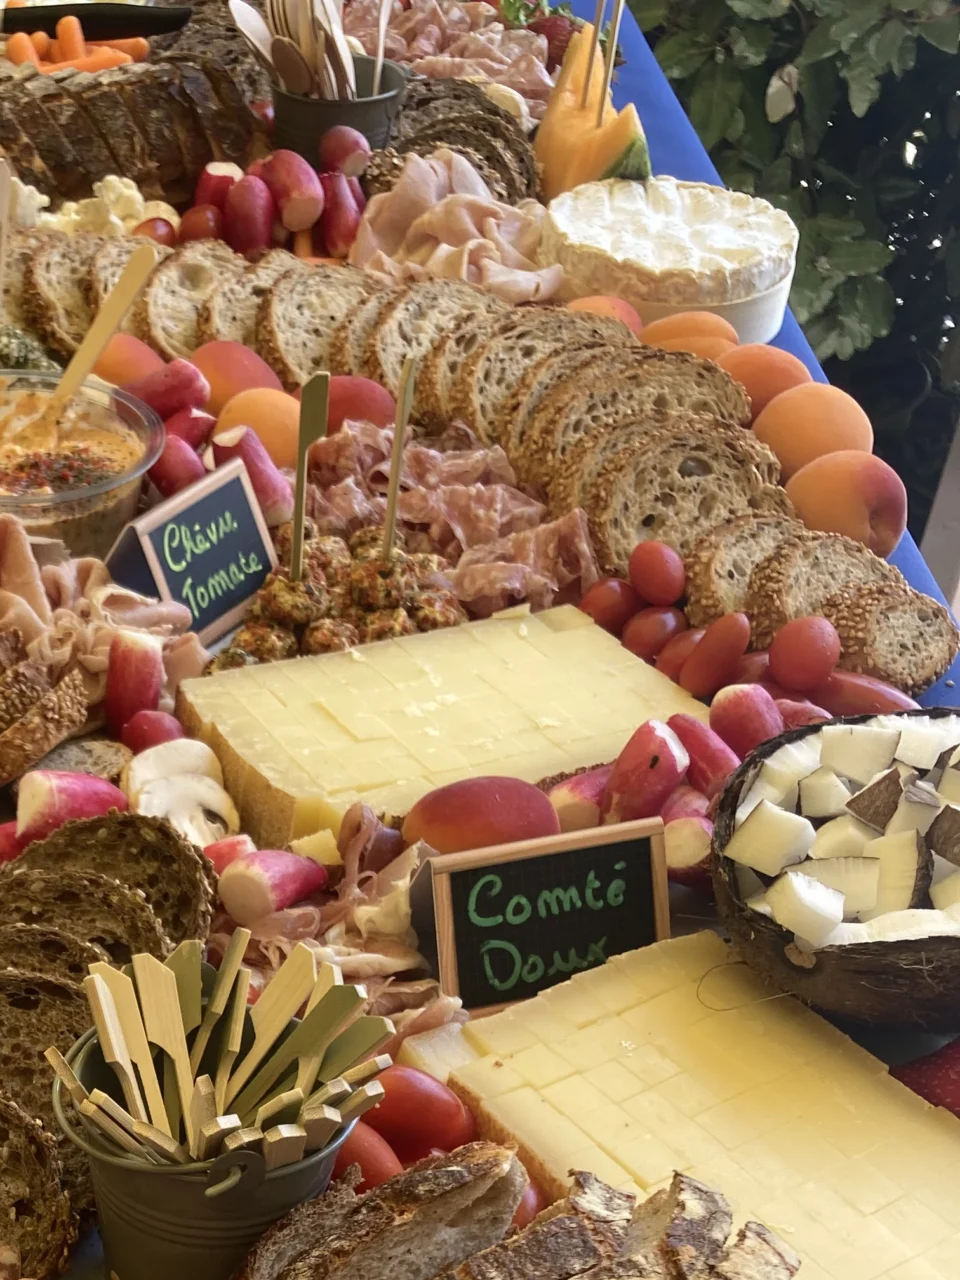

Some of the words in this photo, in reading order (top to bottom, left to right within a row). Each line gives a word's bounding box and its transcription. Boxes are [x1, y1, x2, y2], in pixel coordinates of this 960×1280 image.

[181, 552, 263, 619] Tomate
[467, 861, 627, 927] Comté
[480, 936, 608, 991] Doux
